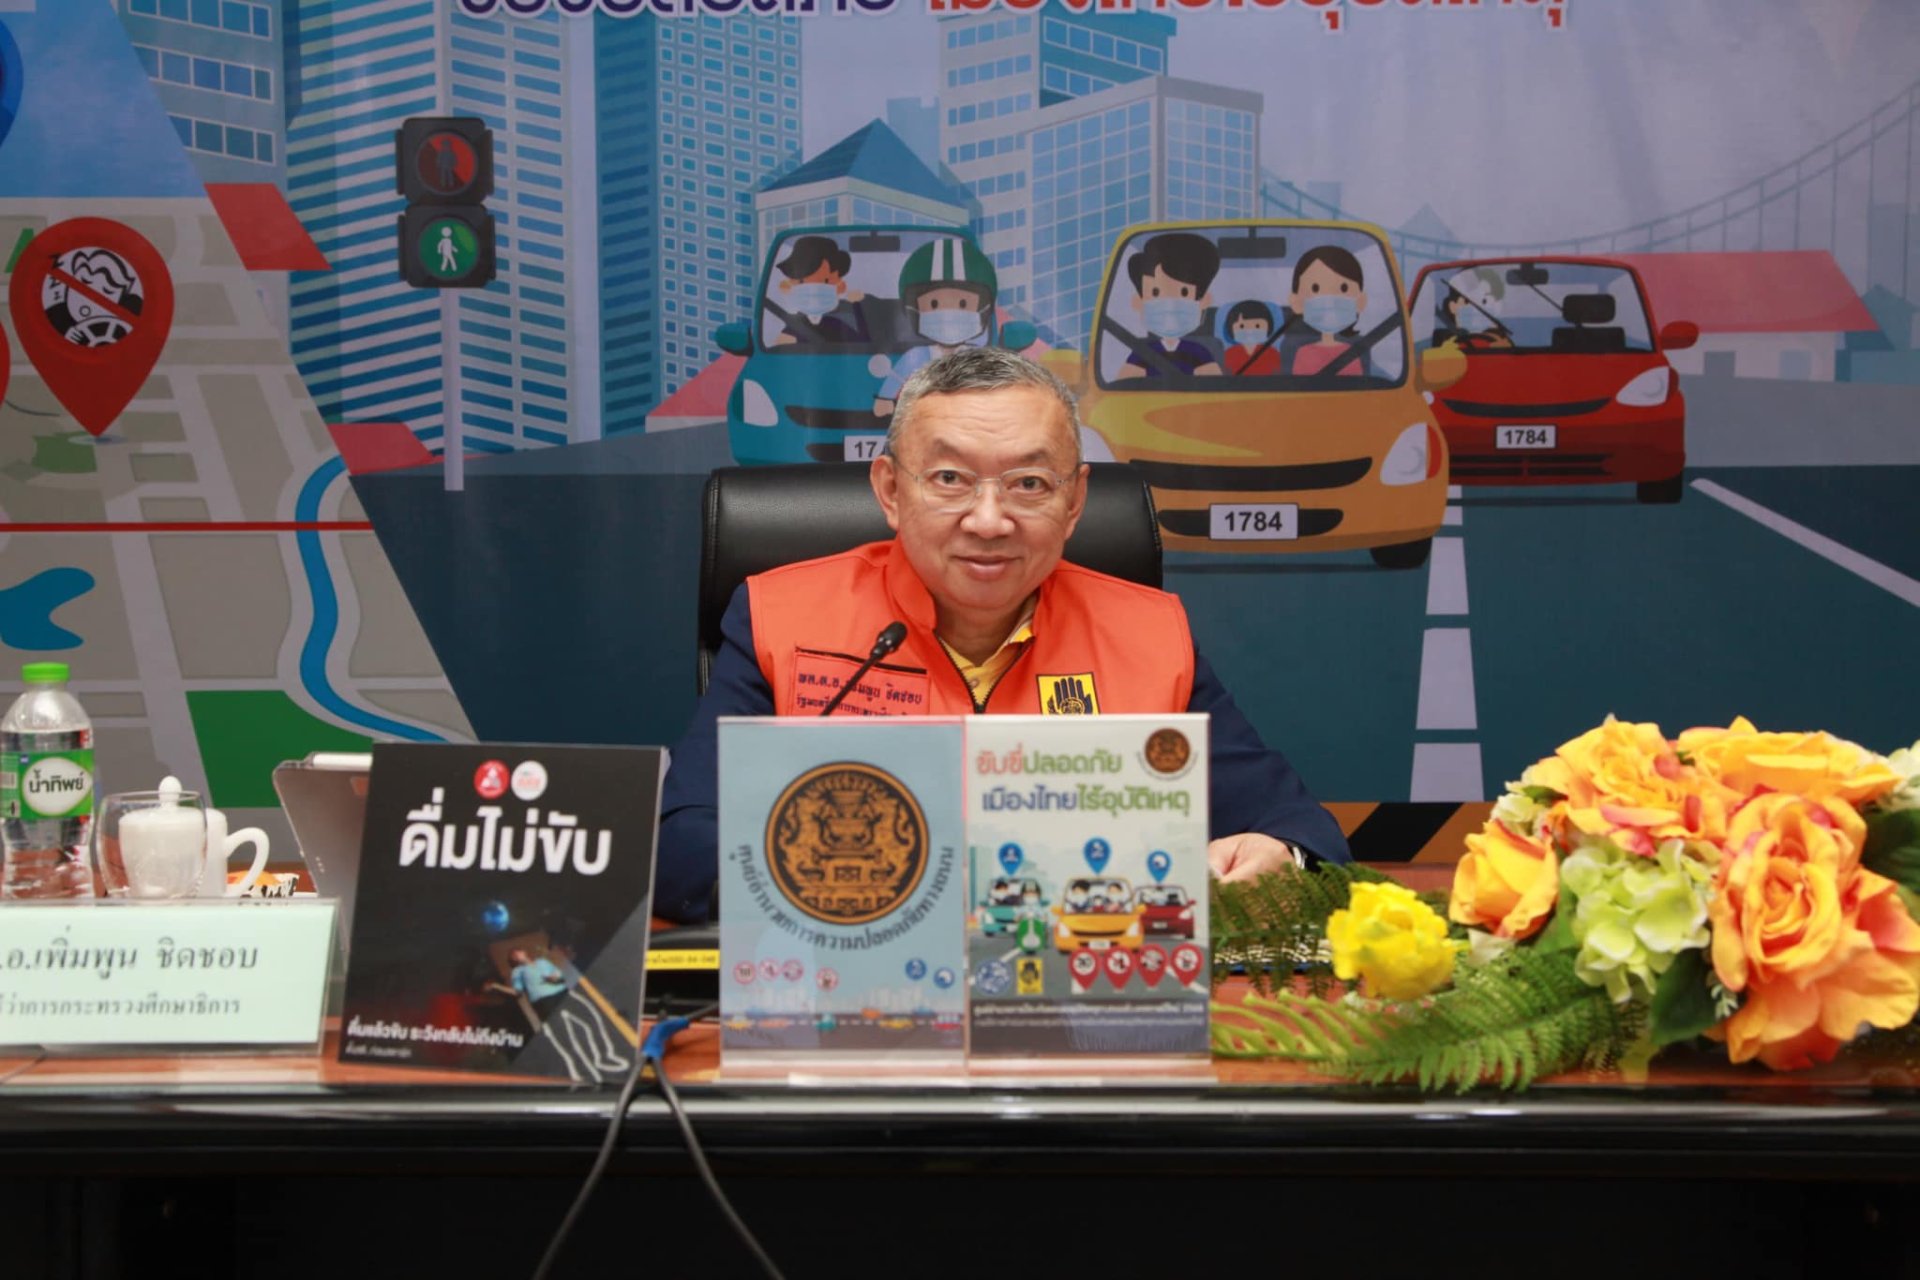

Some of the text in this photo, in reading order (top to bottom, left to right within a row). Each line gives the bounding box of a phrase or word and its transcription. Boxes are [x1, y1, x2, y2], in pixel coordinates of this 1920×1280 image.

[855, 441, 887, 458] 17
[1504, 429, 1547, 445] 1784
[1225, 511, 1282, 532] 1784
[976, 742, 1122, 775] ขับขี่ปลอดภัย
[29, 769, 84, 793] น้ำทิพย์
[982, 783, 1191, 818] เมืองไทยไร้อุบัติเหตุ
[399, 787, 612, 876] ดื่มไม่ขับ
[157, 936, 259, 969] ชิดชอบ
